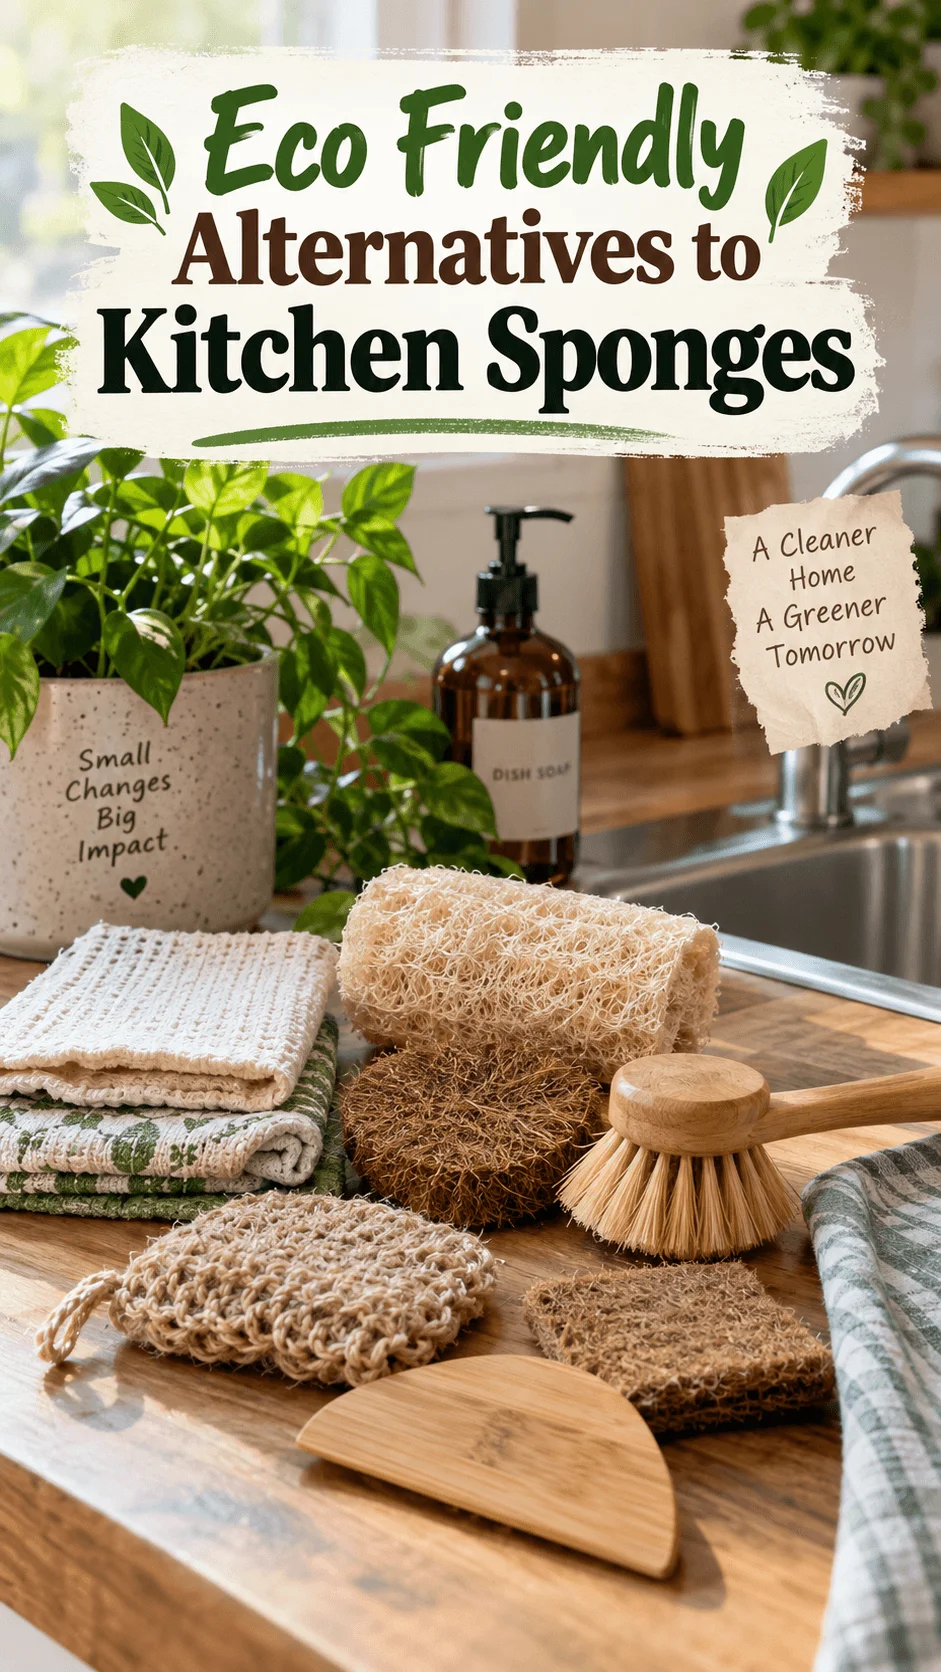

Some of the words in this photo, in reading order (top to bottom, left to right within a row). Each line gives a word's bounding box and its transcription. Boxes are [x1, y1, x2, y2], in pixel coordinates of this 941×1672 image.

[79, 739, 151, 772] Small
[65, 774, 172, 803] Changes
[492, 768, 531, 781] DISH
[97, 806, 136, 834] Big
[78, 827, 169, 867] Impact
